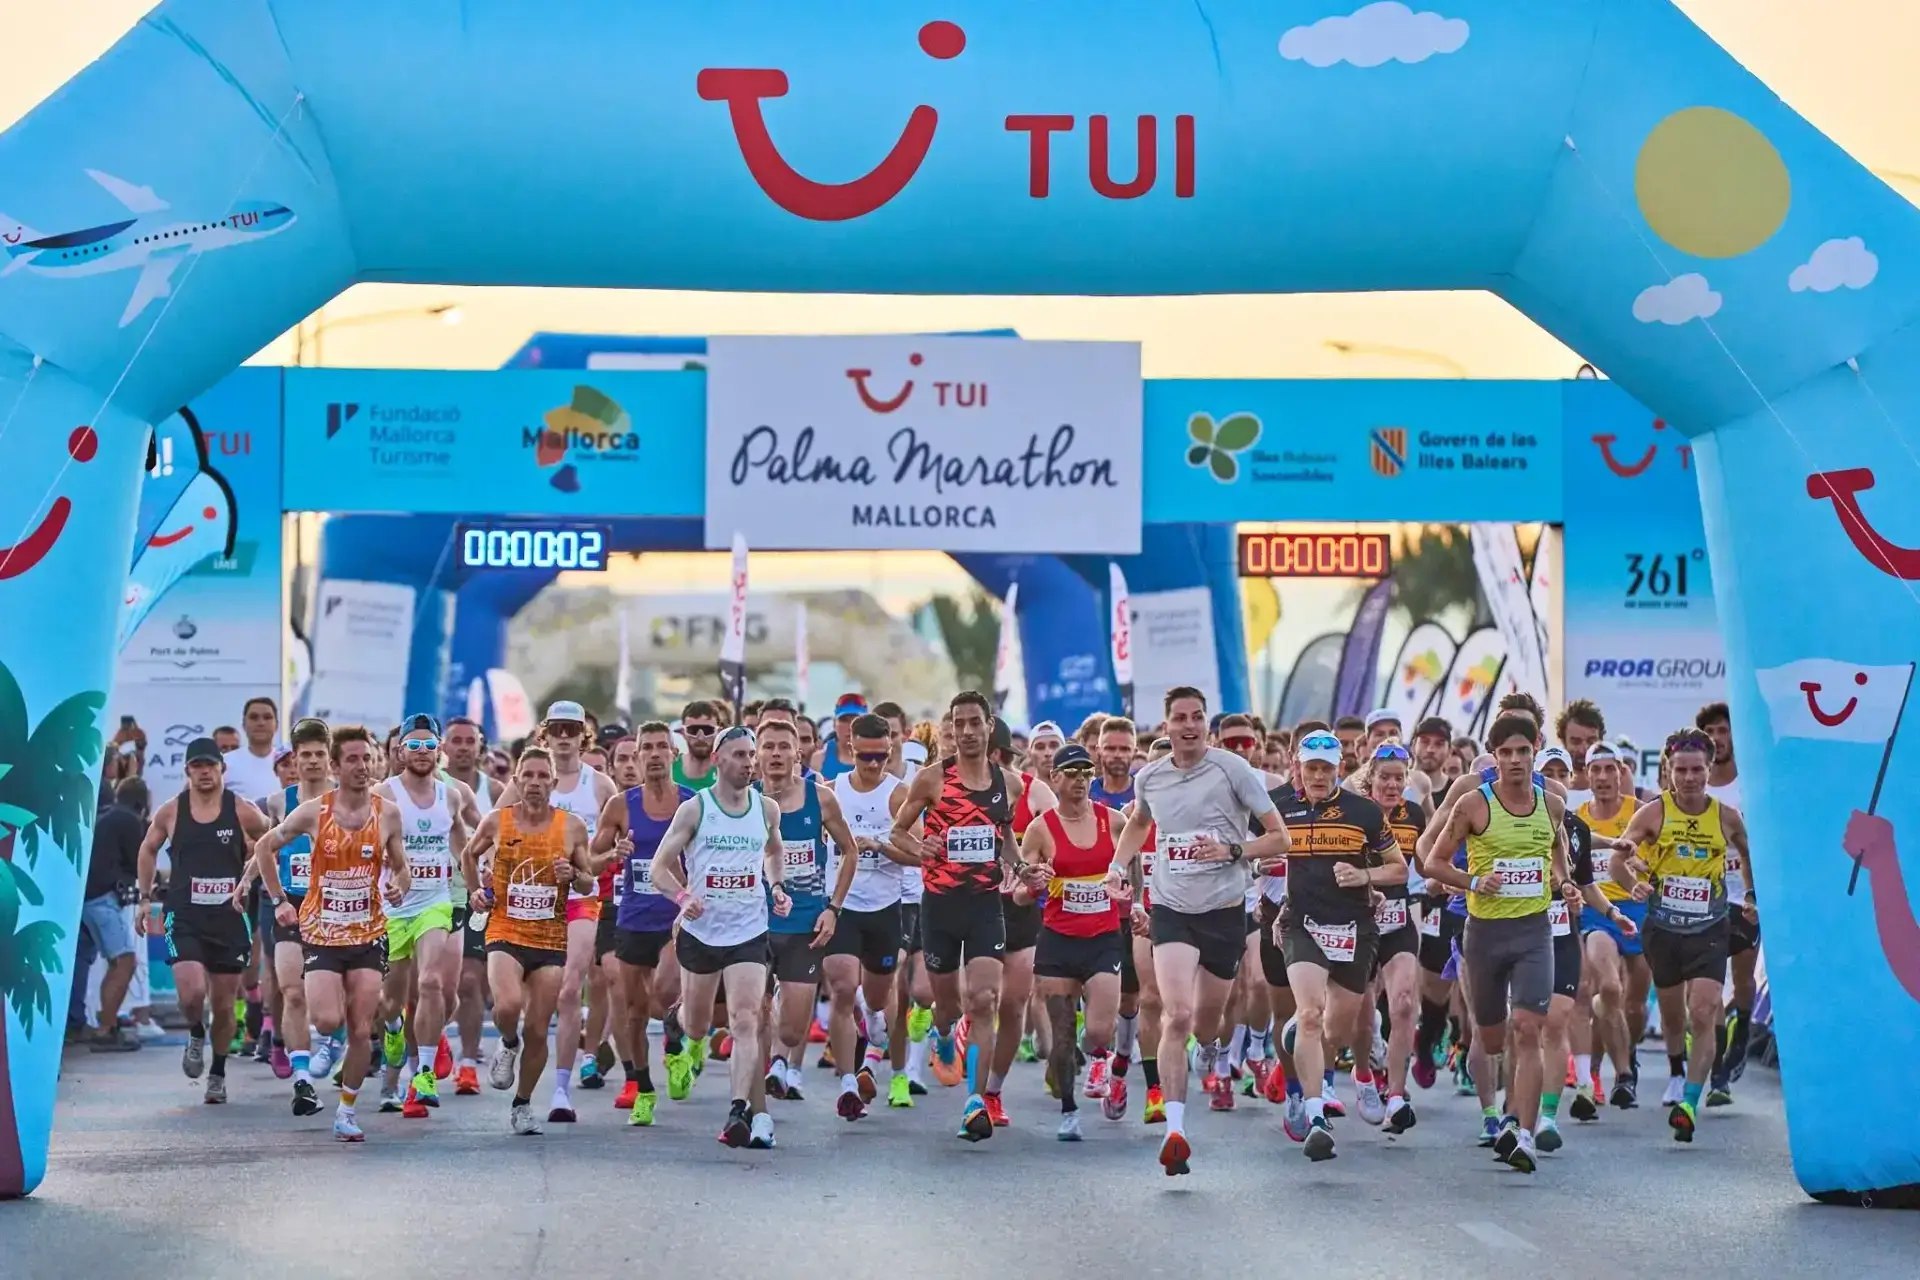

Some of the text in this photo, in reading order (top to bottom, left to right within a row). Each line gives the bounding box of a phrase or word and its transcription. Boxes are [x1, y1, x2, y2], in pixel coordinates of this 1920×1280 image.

[1005, 115, 1195, 199] TUI
[229, 211, 259, 228] TUI
[933, 383, 988, 406] TUI
[370, 404, 461, 422] Fundació
[203, 431, 252, 455] TUI
[370, 426, 456, 444] Mallorca
[522, 427, 640, 450] Mallorca
[1419, 430, 1538, 448] Govern de les
[370, 448, 450, 466] Turisme
[731, 424, 1118, 493] Palma Marathon
[1419, 453, 1528, 470] Illes Balears
[852, 505, 996, 528] MALLORCA
[1585, 658, 1725, 680] PROAGROU
[706, 835, 749, 845] HEATON
[955, 838, 990, 851] 1216
[1306, 833, 1350, 846] Radkurier
[411, 866, 437, 878] 013
[197, 882, 229, 894] 6709
[712, 876, 749, 889] 5821
[1069, 890, 1105, 903] 5058
[1669, 887, 1704, 900] 6642
[328, 900, 364, 912] 4816
[514, 897, 550, 909] 5850
[1313, 932, 1348, 949] 957
